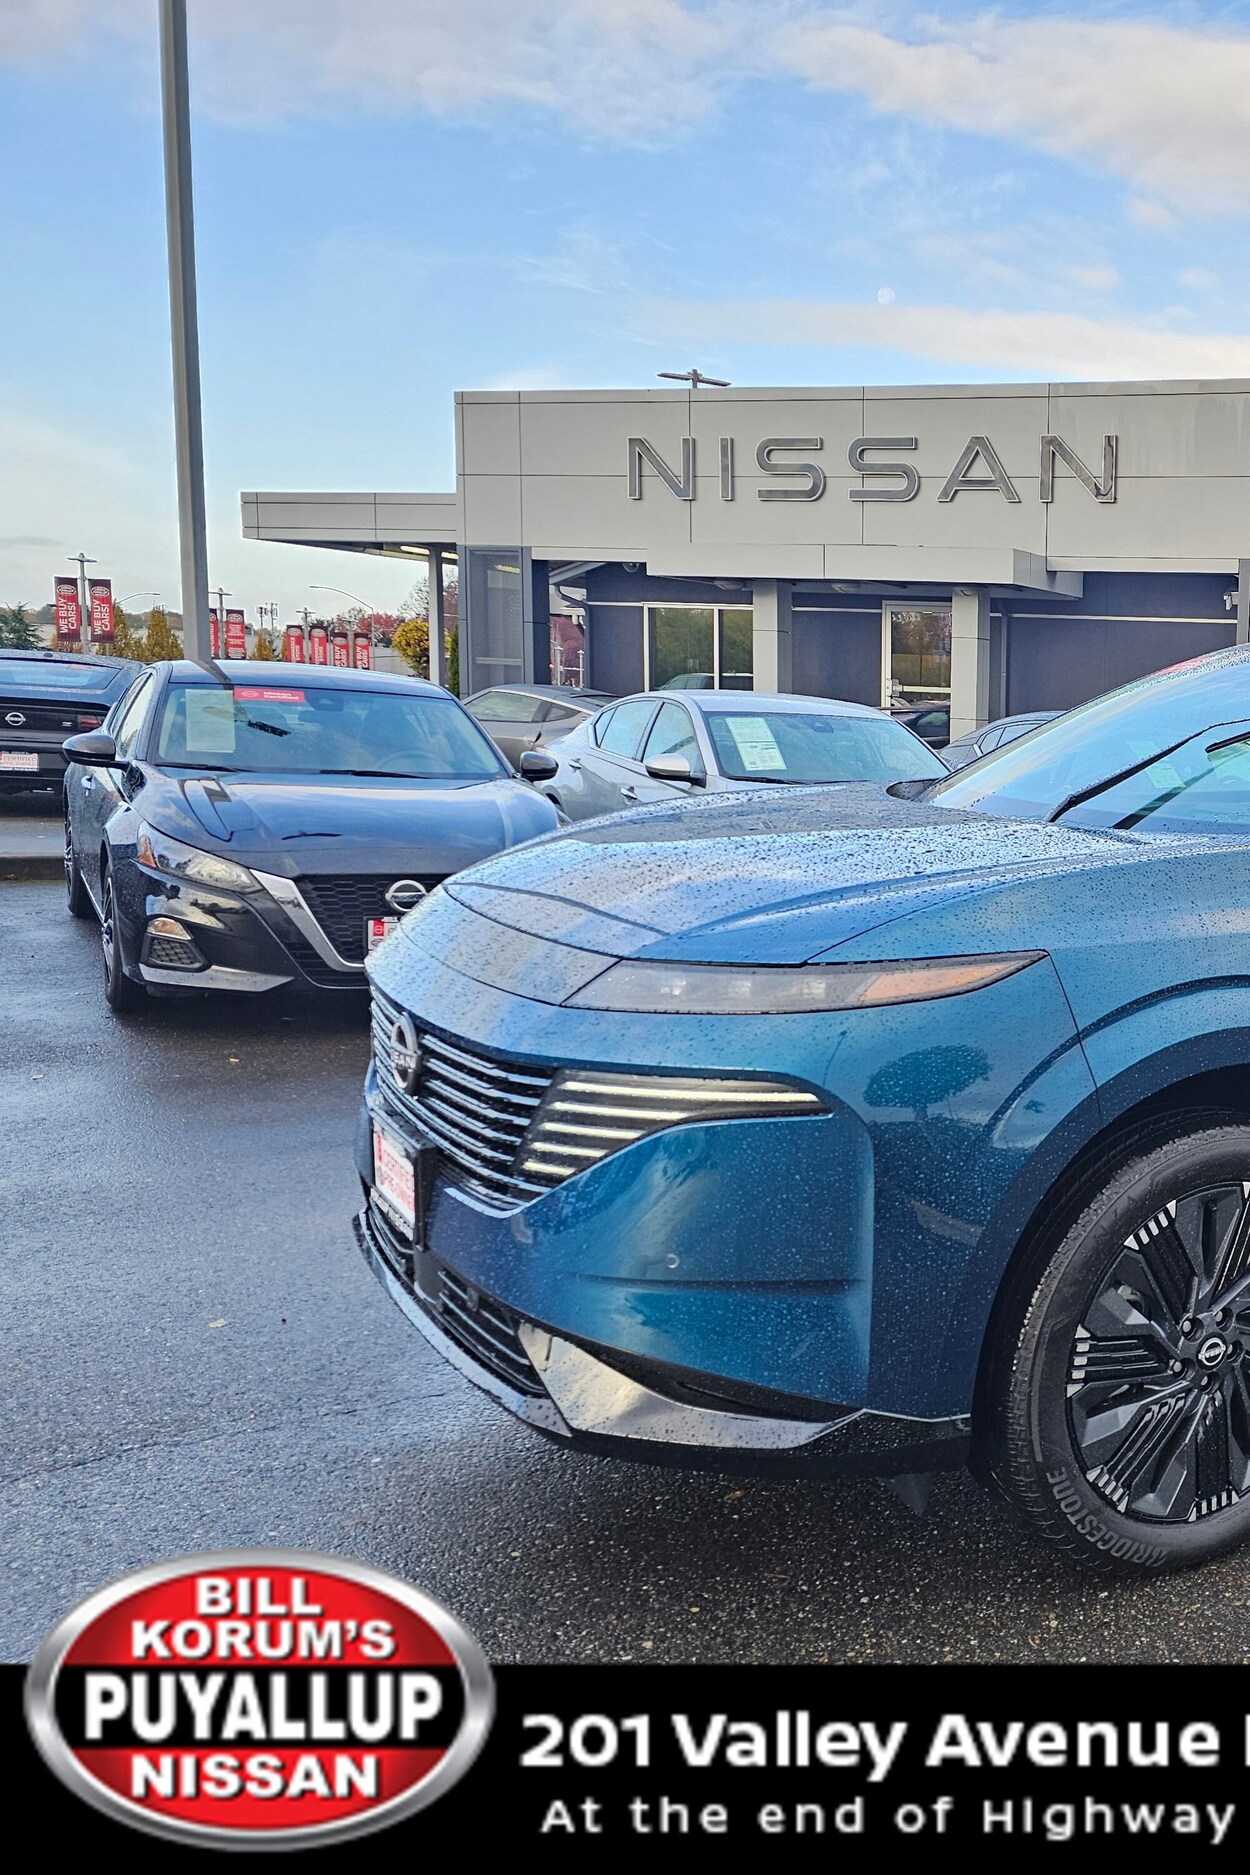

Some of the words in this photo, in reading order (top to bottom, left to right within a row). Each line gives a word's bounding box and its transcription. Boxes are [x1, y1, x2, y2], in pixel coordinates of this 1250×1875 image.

[626, 433, 1118, 503] NISSAN
[58, 597, 68, 617] BUY
[68, 602, 77, 630] CARS!
[93, 598, 101, 619] BUY
[101, 603, 110, 631] CARS!
[59, 618, 68, 634] WE
[93, 618, 102, 635] WE
[1046, 1466, 1172, 1568] BRIDGESTONE
